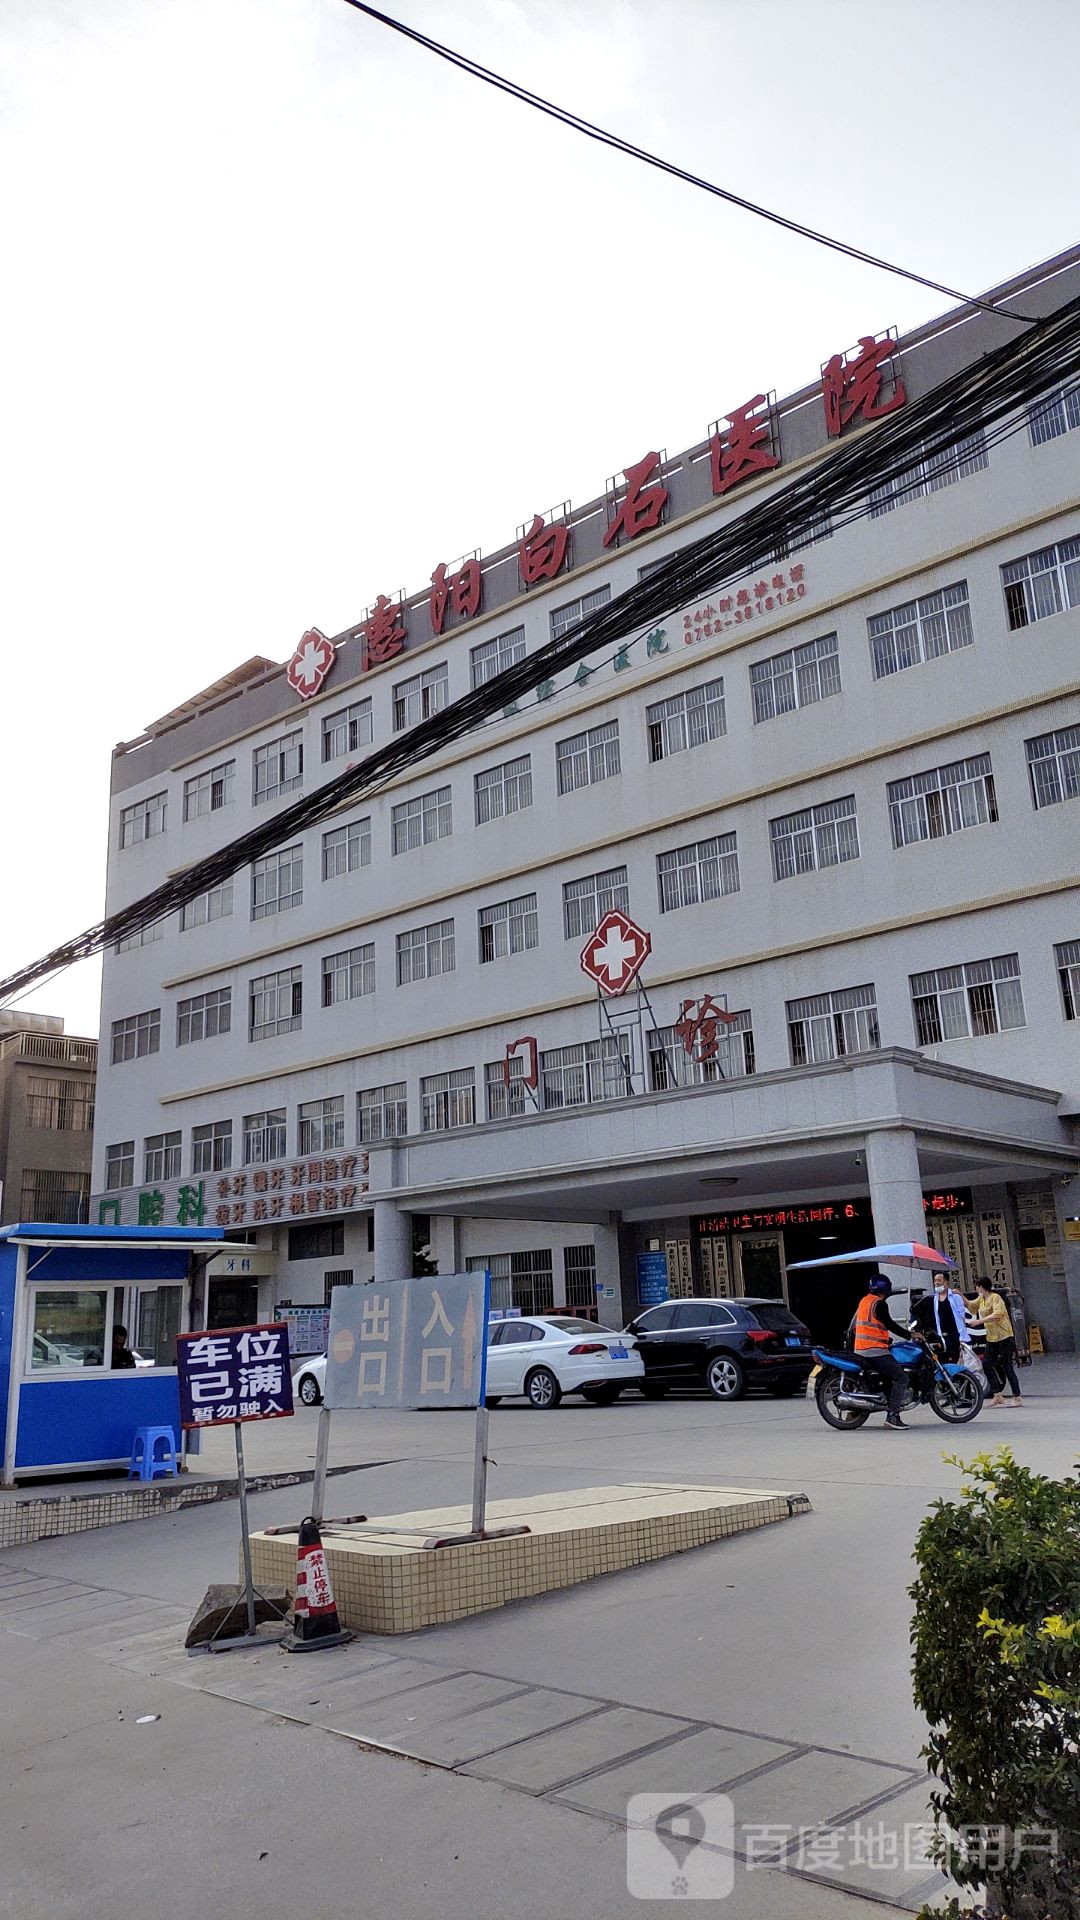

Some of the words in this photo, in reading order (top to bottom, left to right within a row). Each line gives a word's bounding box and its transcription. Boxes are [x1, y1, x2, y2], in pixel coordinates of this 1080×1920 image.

[361, 336, 906, 671] 惠阳白石医院
[683, 563, 805, 629] 24小时急诊电话
[684, 583, 806, 645] 0752-3818120
[99, 1181, 205, 1226] 口腔科
[226, 1258, 250, 1272] 牙科
[186, 1331, 282, 1368] 车位
[358, 1294, 390, 1396] 出口
[420, 1290, 455, 1395] 入口
[189, 1364, 283, 1403] 已满
[192, 1398, 283, 1422] 暂勿驶入
[309, 1553, 331, 1605] 禁止停车
